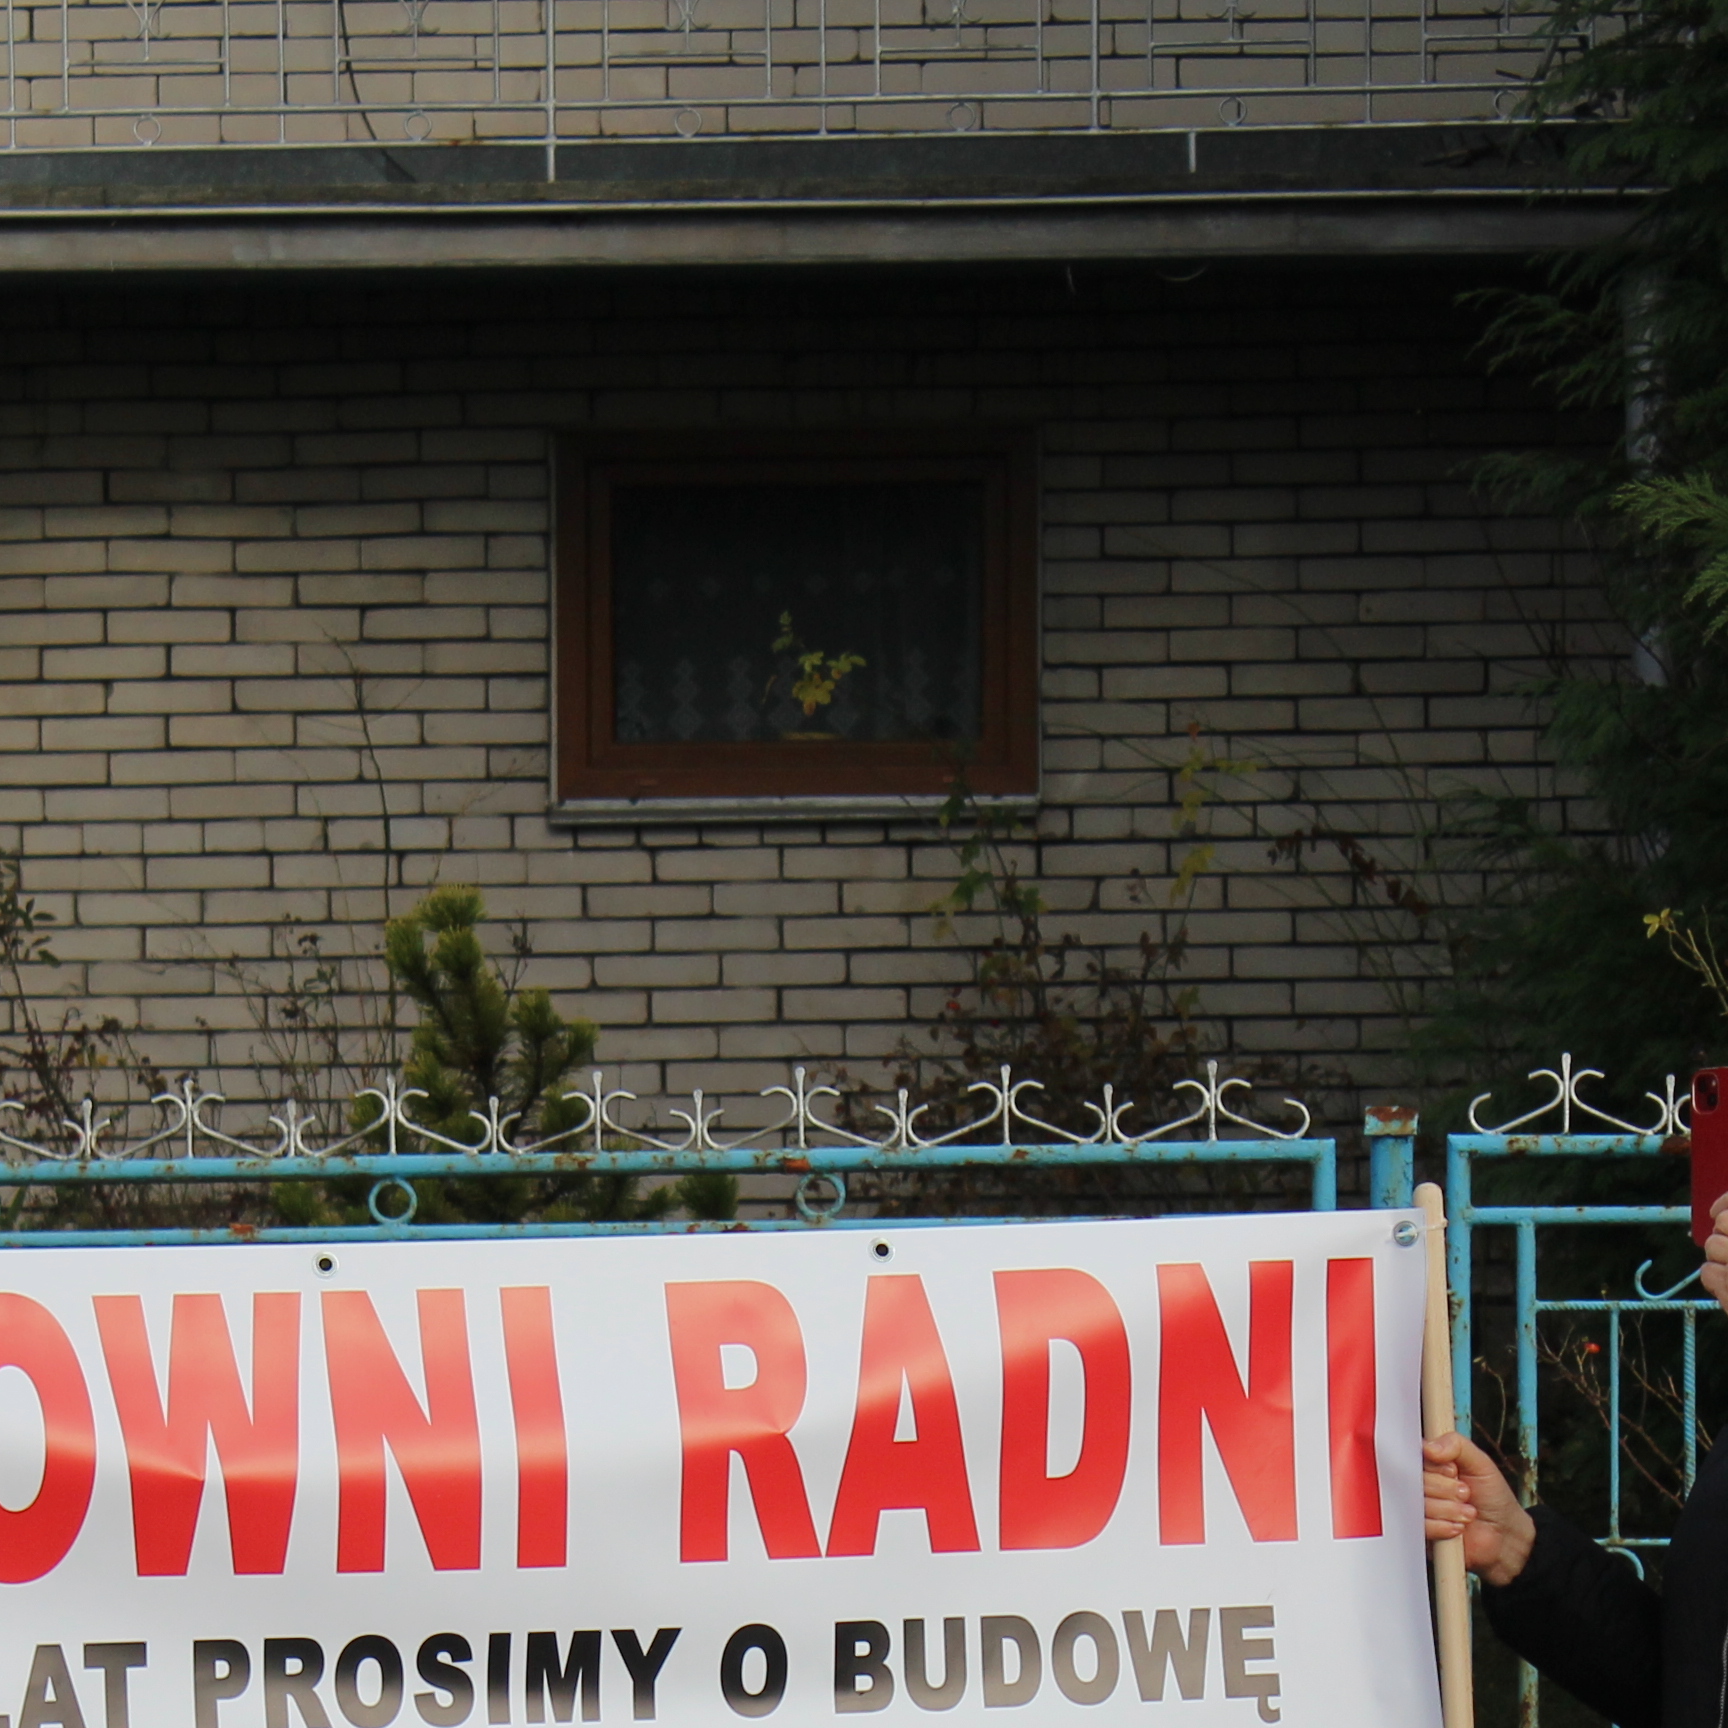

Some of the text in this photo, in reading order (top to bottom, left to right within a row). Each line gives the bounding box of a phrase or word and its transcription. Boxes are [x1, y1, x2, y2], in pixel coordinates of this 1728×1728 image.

[665, 1257, 1383, 1563] RADNI
[720, 1623, 788, 1717] O
[834, 1606, 1280, 1723] BUDOWĘ
